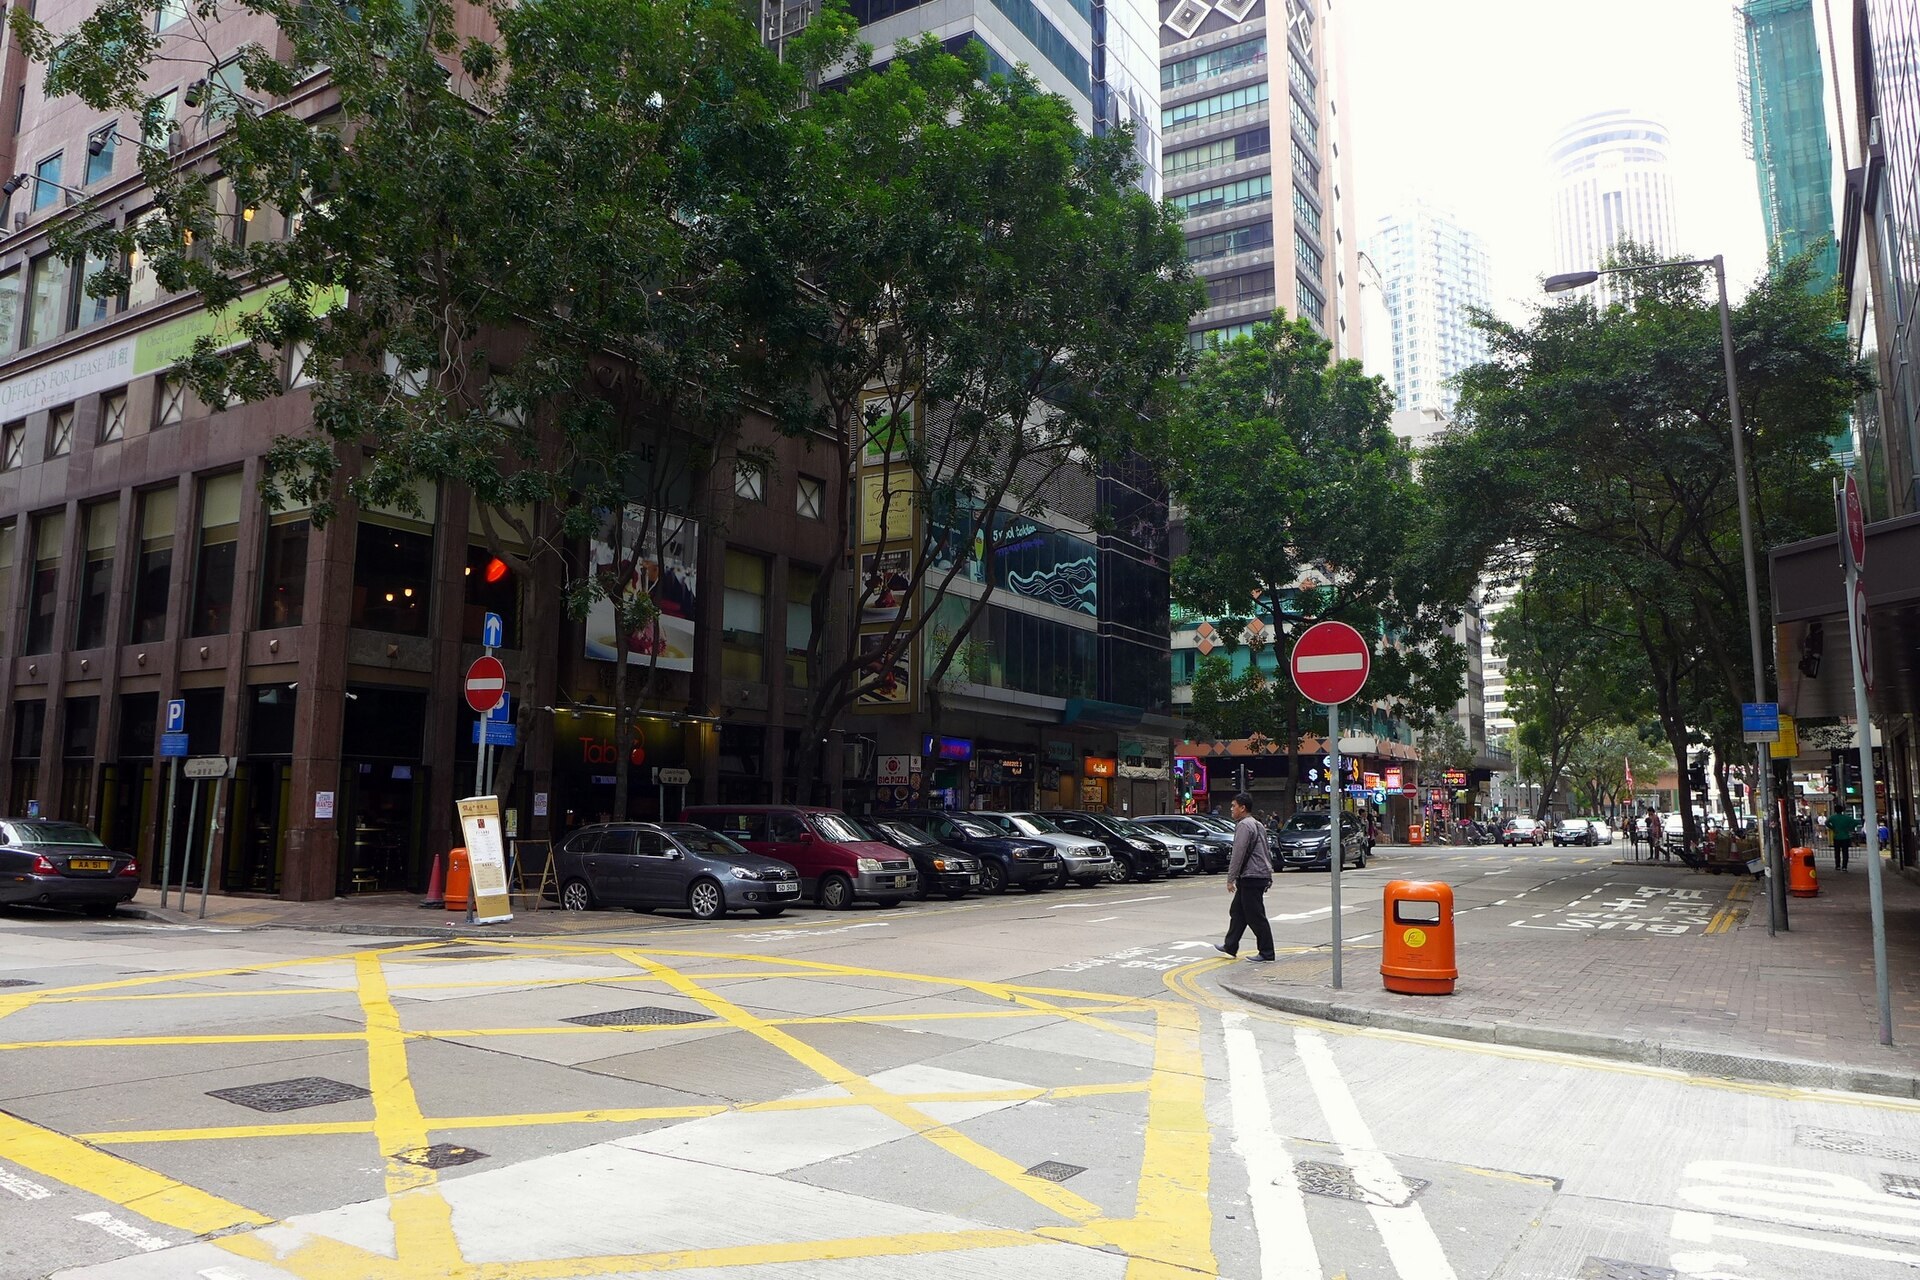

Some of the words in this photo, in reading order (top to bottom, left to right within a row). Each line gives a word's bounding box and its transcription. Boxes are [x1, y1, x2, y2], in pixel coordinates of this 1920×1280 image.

[1, 374, 47, 405] OFFICES
[50, 370, 70, 389] FOR
[74, 356, 103, 381] LEASE
[106, 346, 129, 370] 出租
[169, 704, 181, 728] P
[890, 776, 907, 784] PIZZA
[1556, 918, 1690, 937] BUS
